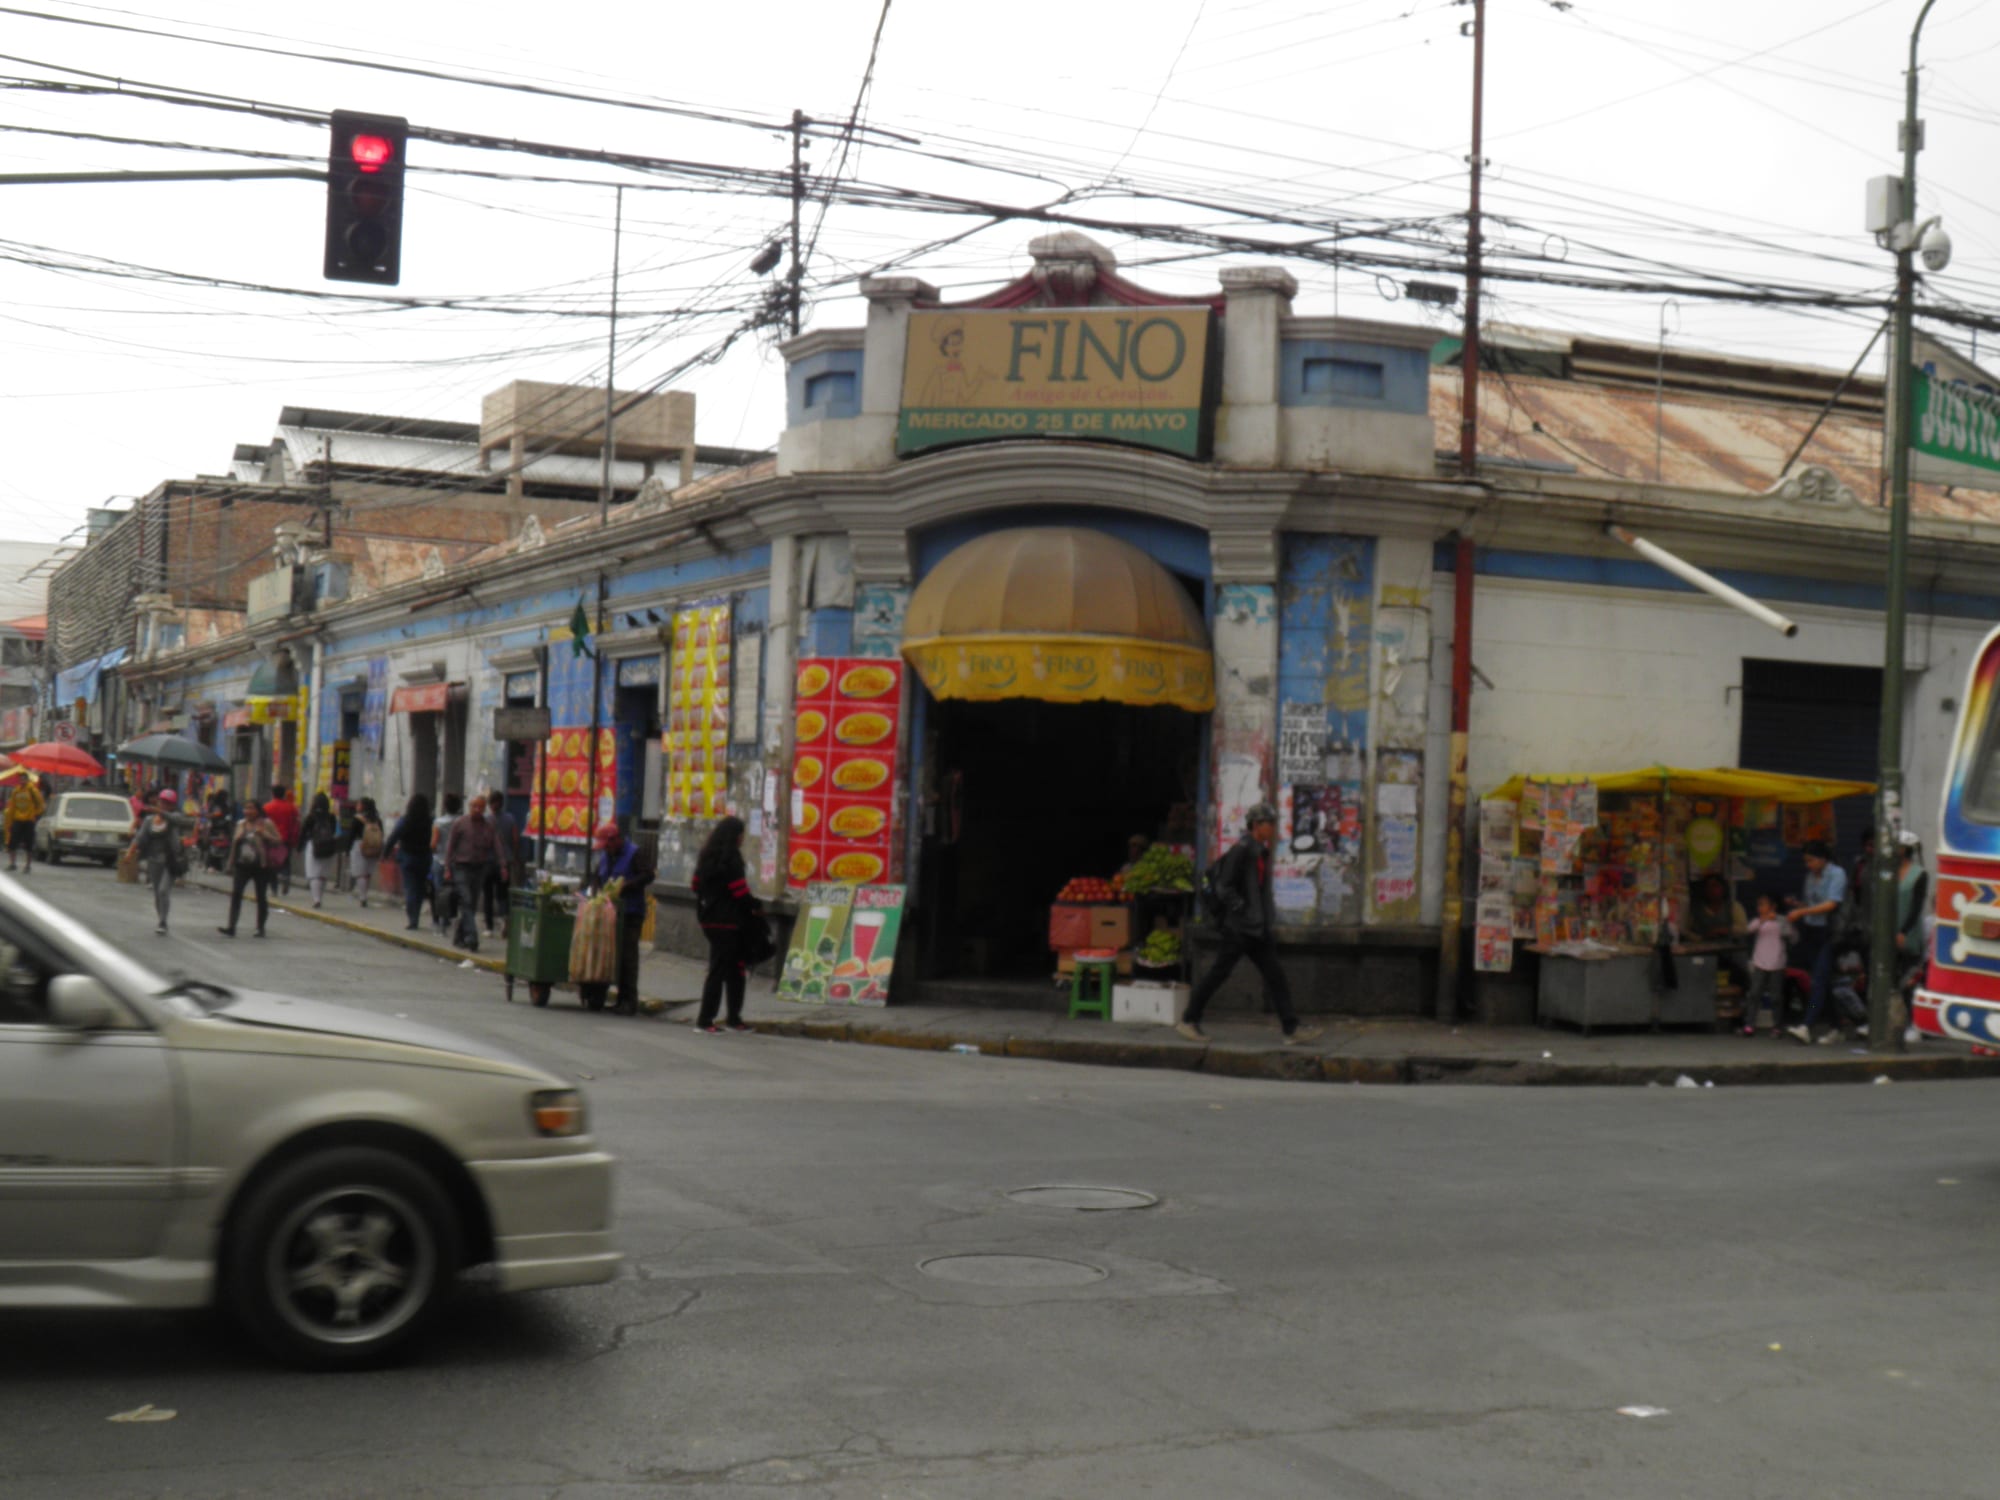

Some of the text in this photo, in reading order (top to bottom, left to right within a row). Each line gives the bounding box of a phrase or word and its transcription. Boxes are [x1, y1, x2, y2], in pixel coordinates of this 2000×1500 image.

[1005, 317, 1186, 383] FINO
[908, 412, 1188, 431] MERCADO 25 DE MAYO
[970, 654, 1016, 673] FINO
[1046, 655, 1096, 674] FINO
[1125, 657, 1164, 680] FINO
